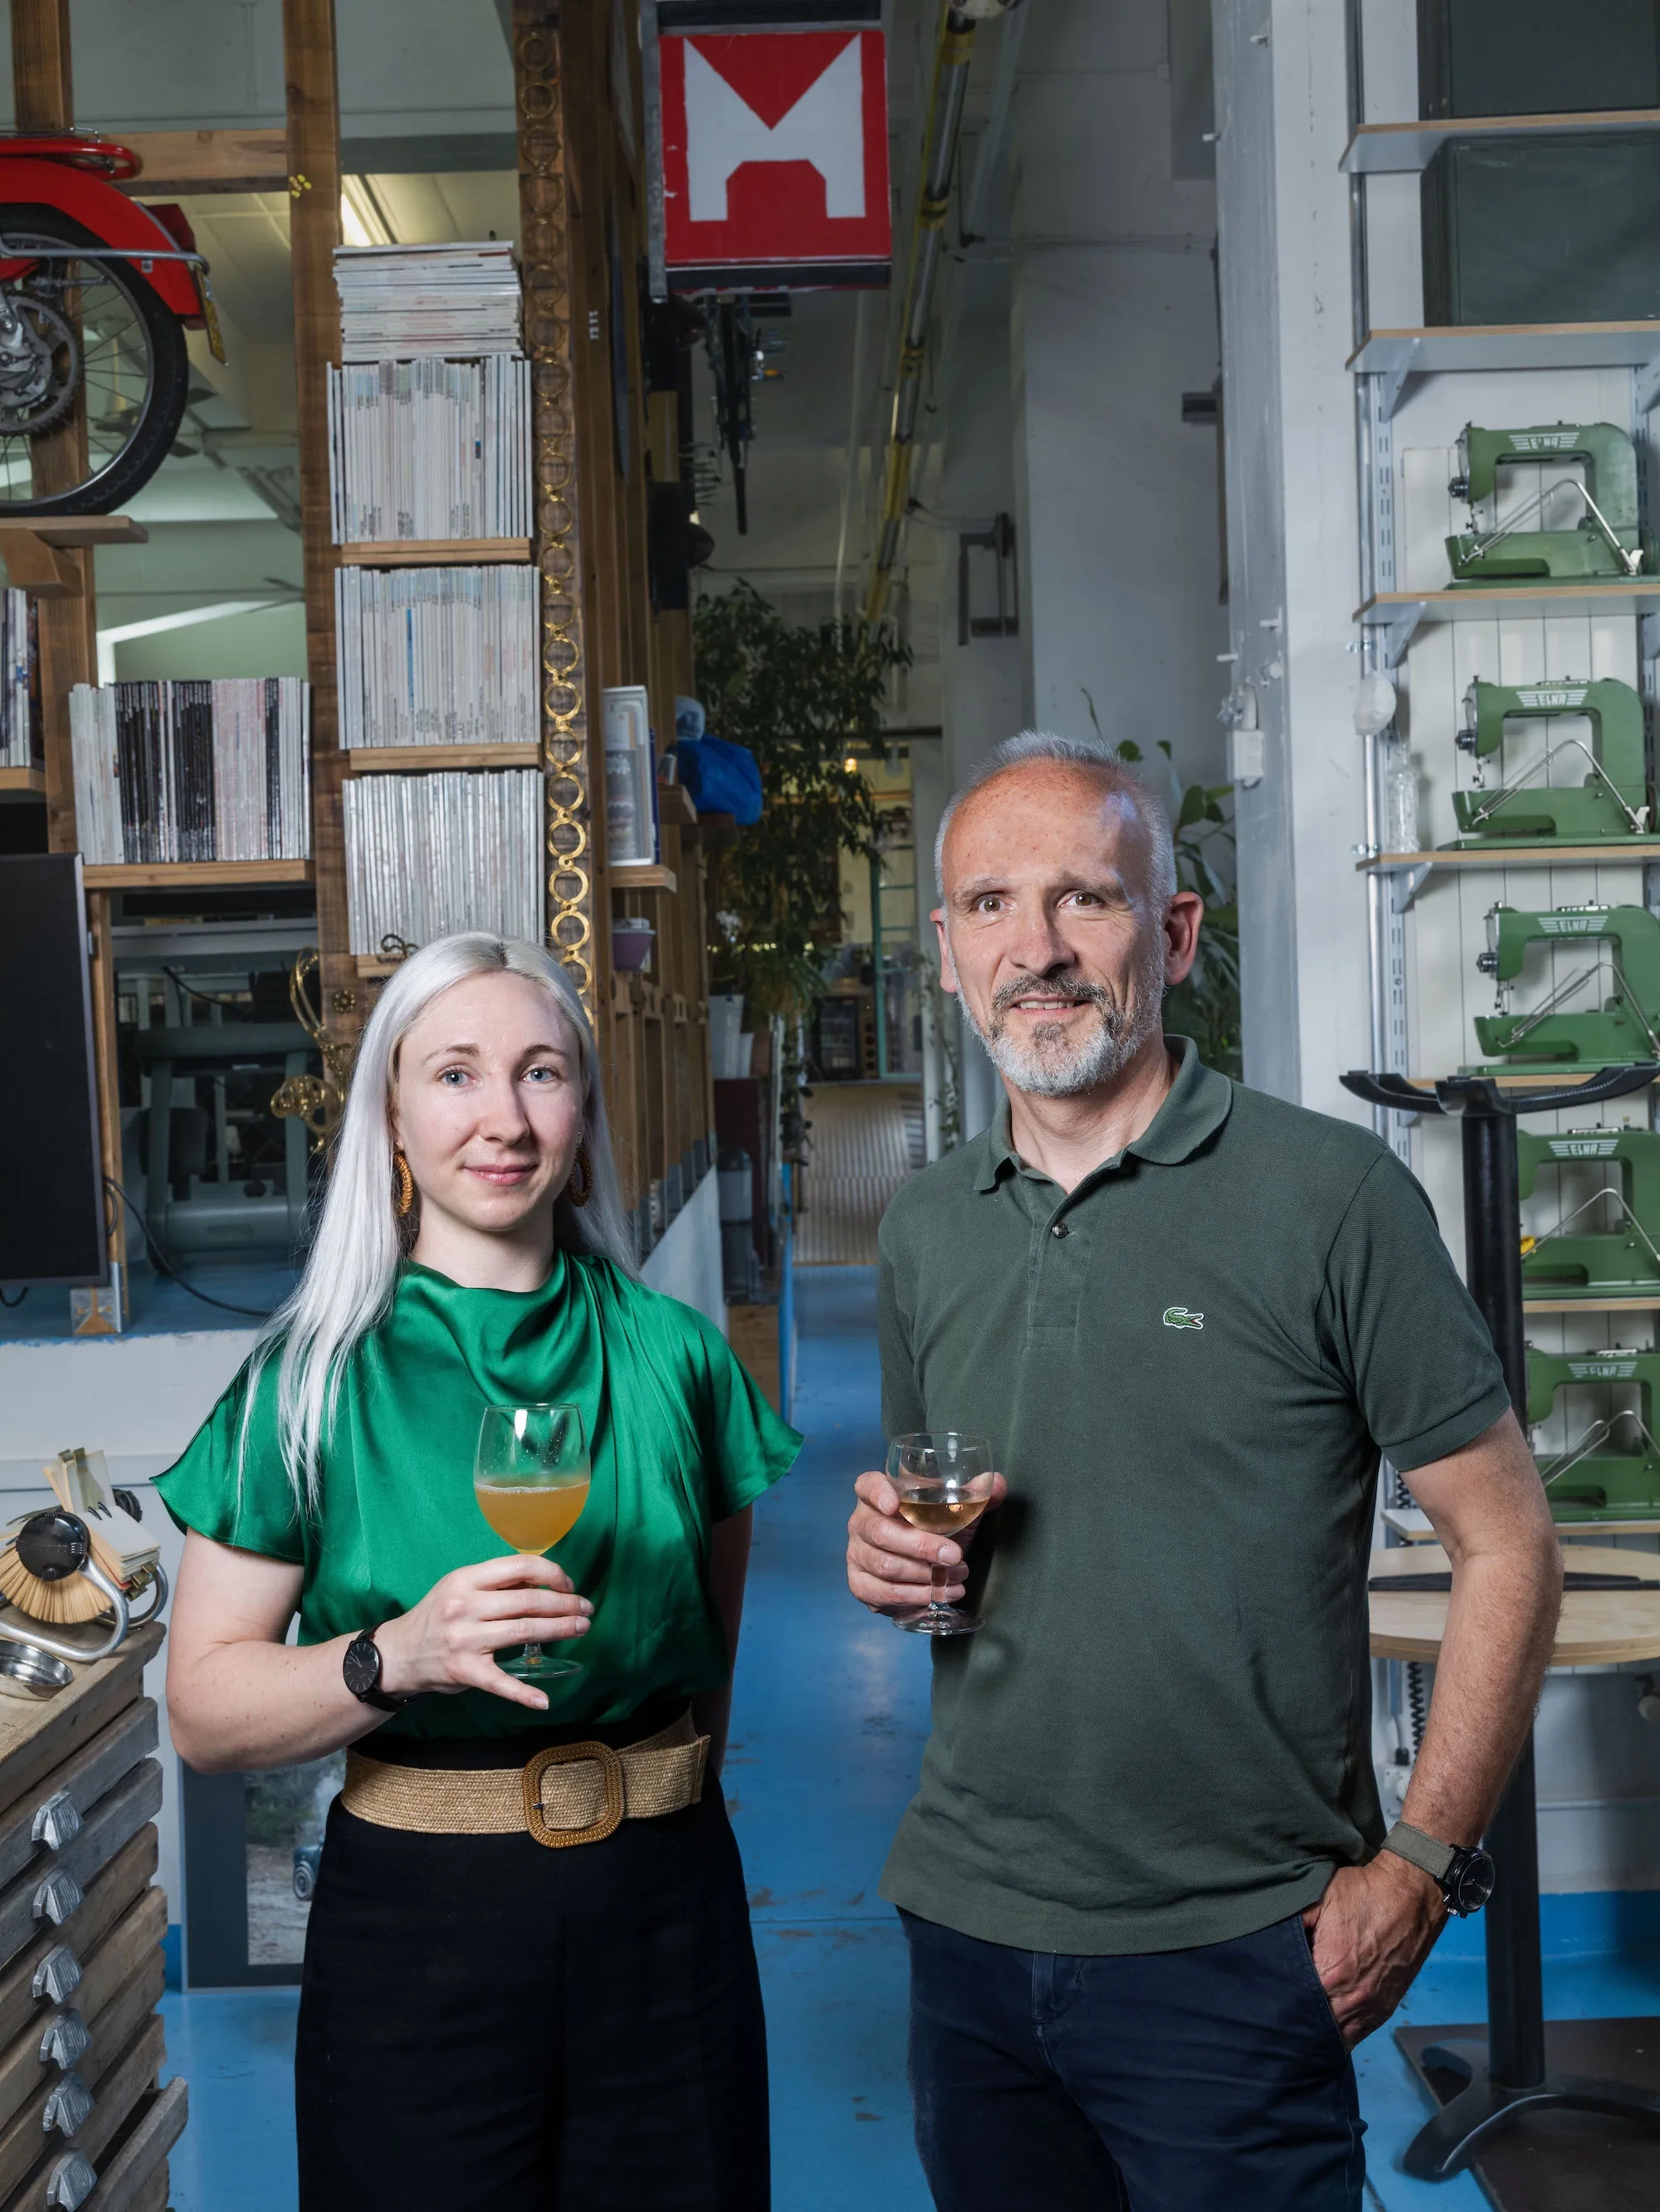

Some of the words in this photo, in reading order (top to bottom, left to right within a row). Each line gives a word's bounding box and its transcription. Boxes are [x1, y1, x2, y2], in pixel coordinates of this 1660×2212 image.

[1537, 693, 1567, 706] ELNA
[1559, 920, 1588, 933] ELNA
[1570, 1143, 1599, 1156] ELNA
